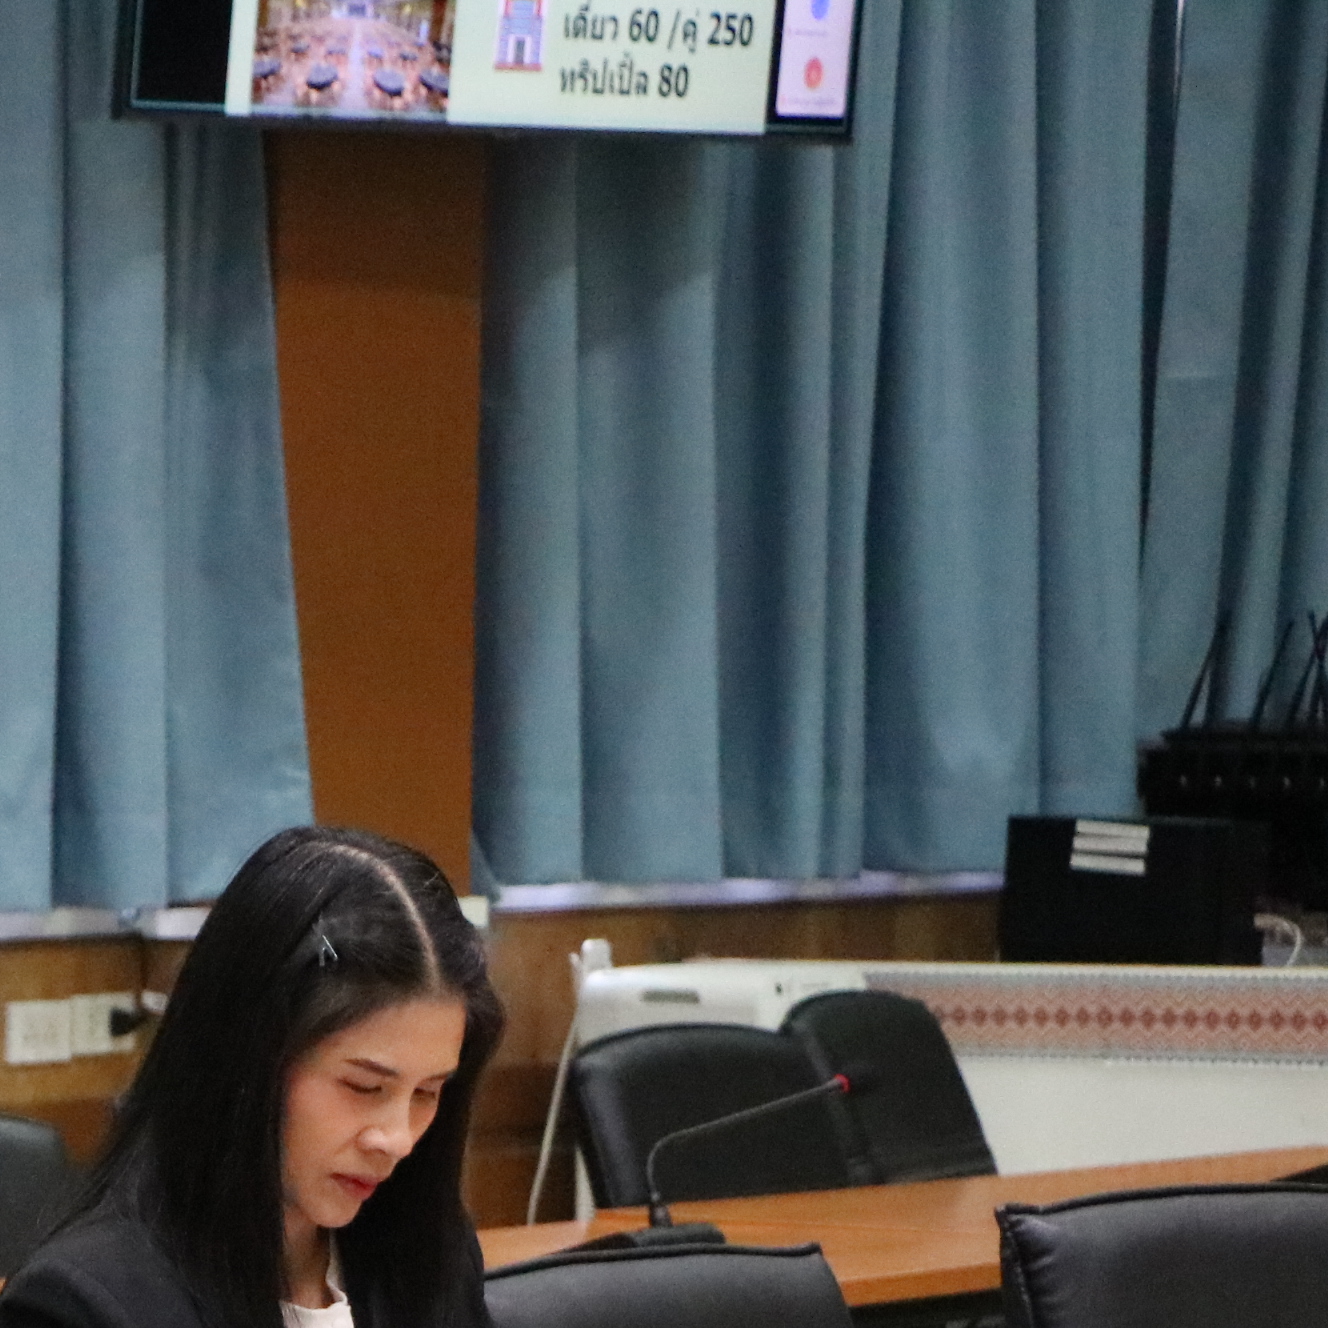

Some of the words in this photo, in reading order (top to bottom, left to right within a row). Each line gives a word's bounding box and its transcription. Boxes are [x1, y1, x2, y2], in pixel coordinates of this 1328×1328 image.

[628, 8, 660, 43] 60
[707, 11, 754, 46] 250
[658, 63, 690, 98] 80
